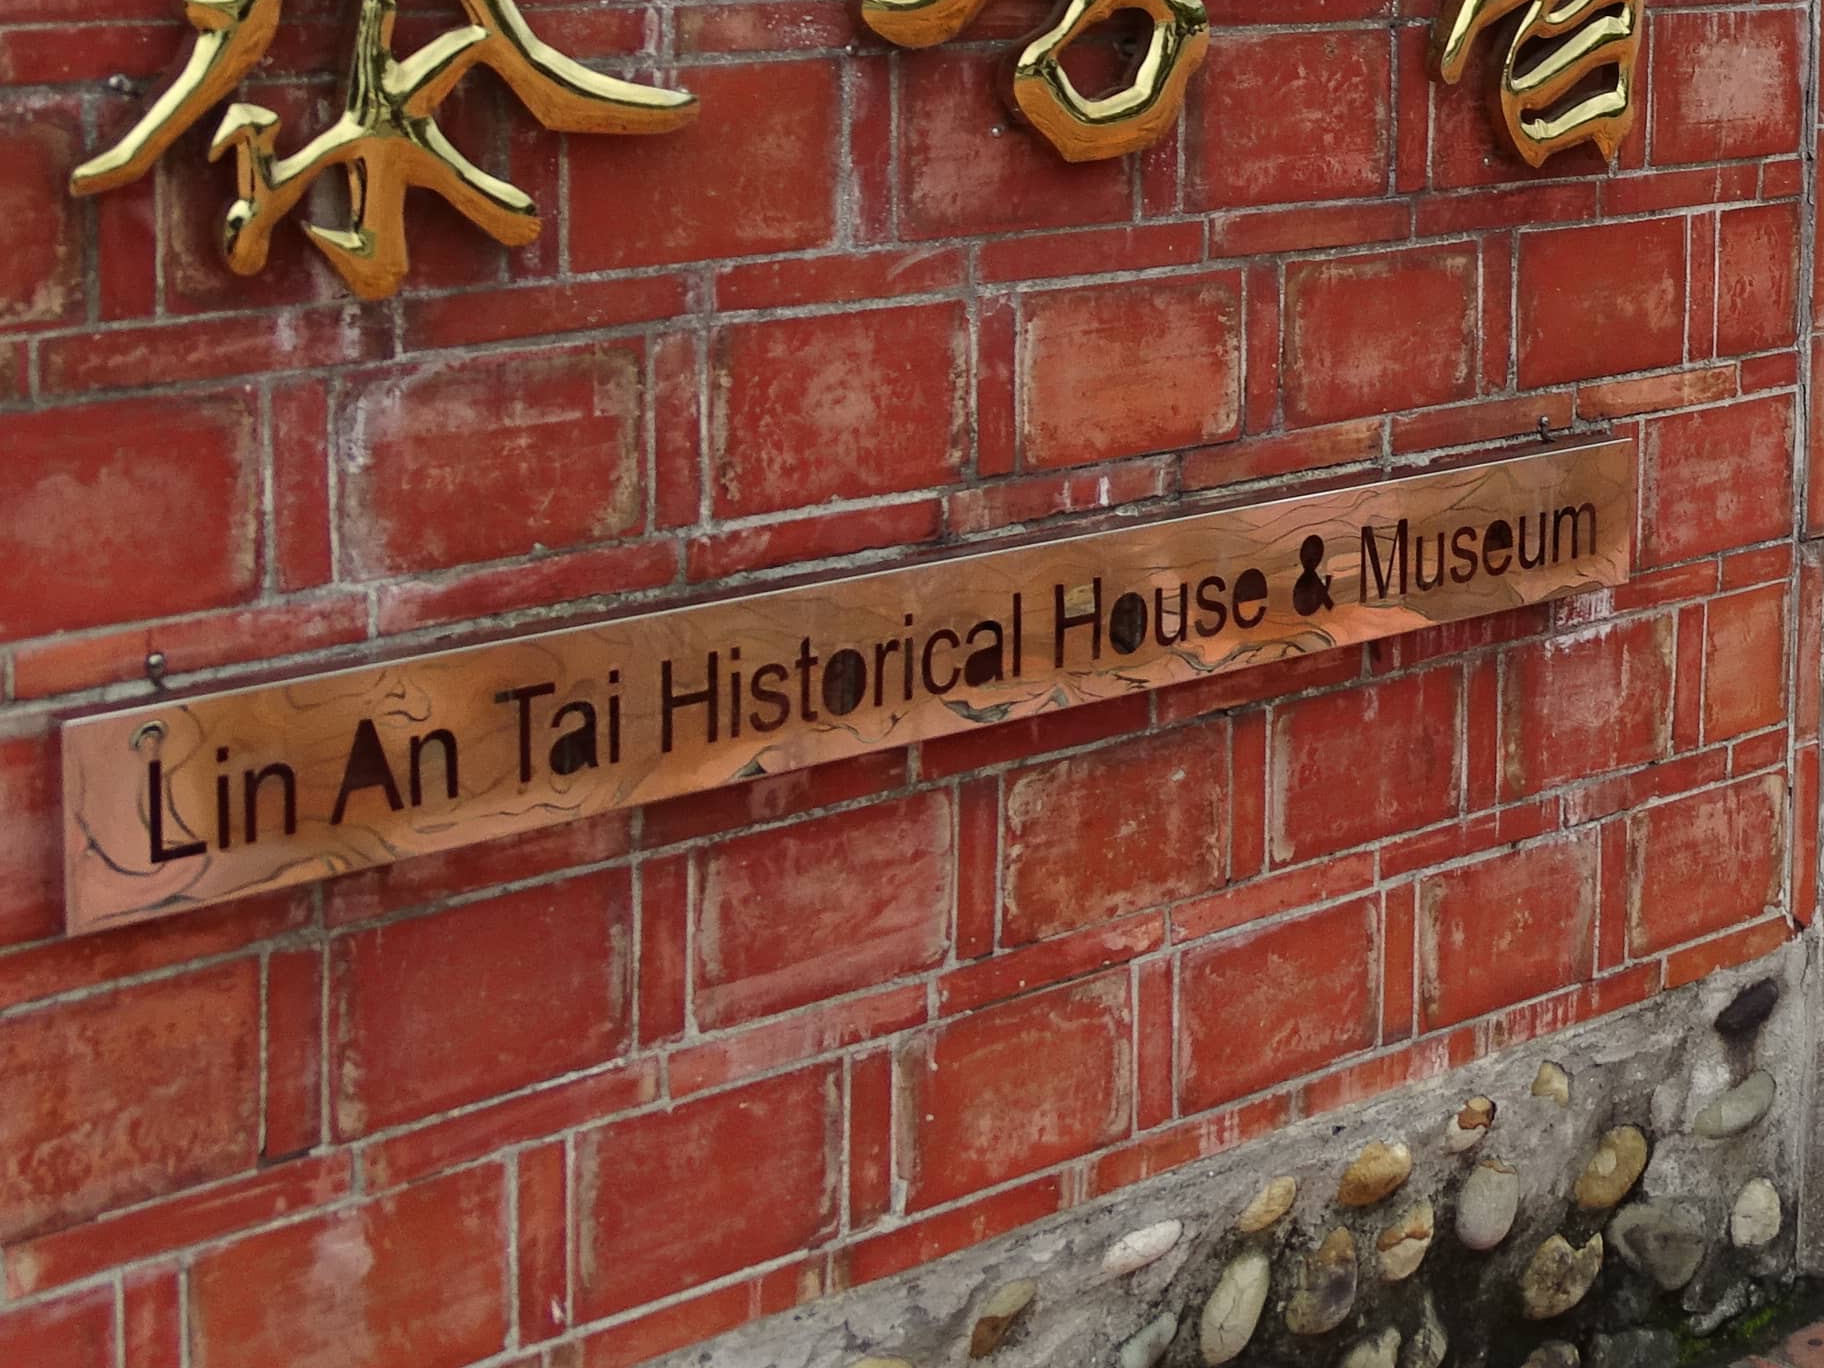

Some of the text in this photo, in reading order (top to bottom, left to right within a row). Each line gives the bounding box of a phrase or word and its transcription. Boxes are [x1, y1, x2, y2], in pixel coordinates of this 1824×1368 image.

[147, 501, 1598, 864] Lin An Tai Historical House & Museum
